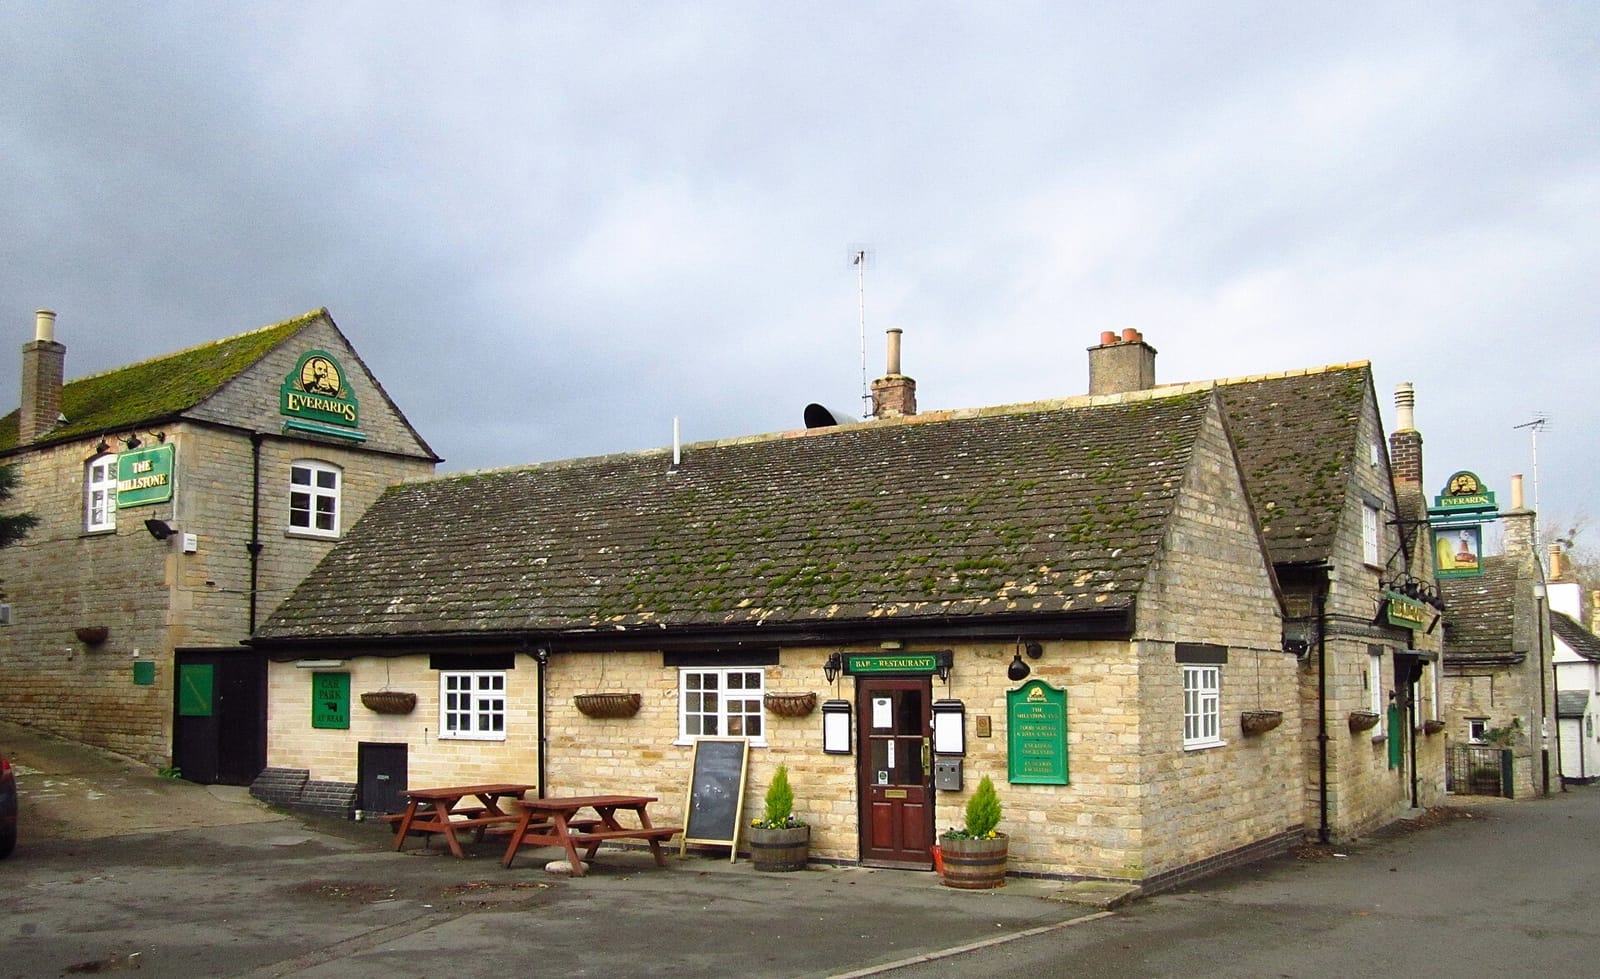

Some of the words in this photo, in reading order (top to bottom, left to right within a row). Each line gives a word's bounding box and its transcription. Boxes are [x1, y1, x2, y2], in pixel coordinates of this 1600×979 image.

[287, 393, 355, 421] EVERARDS
[132, 460, 152, 473] THE
[117, 474, 167, 491] MILLSTONE
[1441, 496, 1489, 507] EVERARDS
[855, 660, 871, 668] BAR
[879, 659, 930, 668] RESTAURANT
